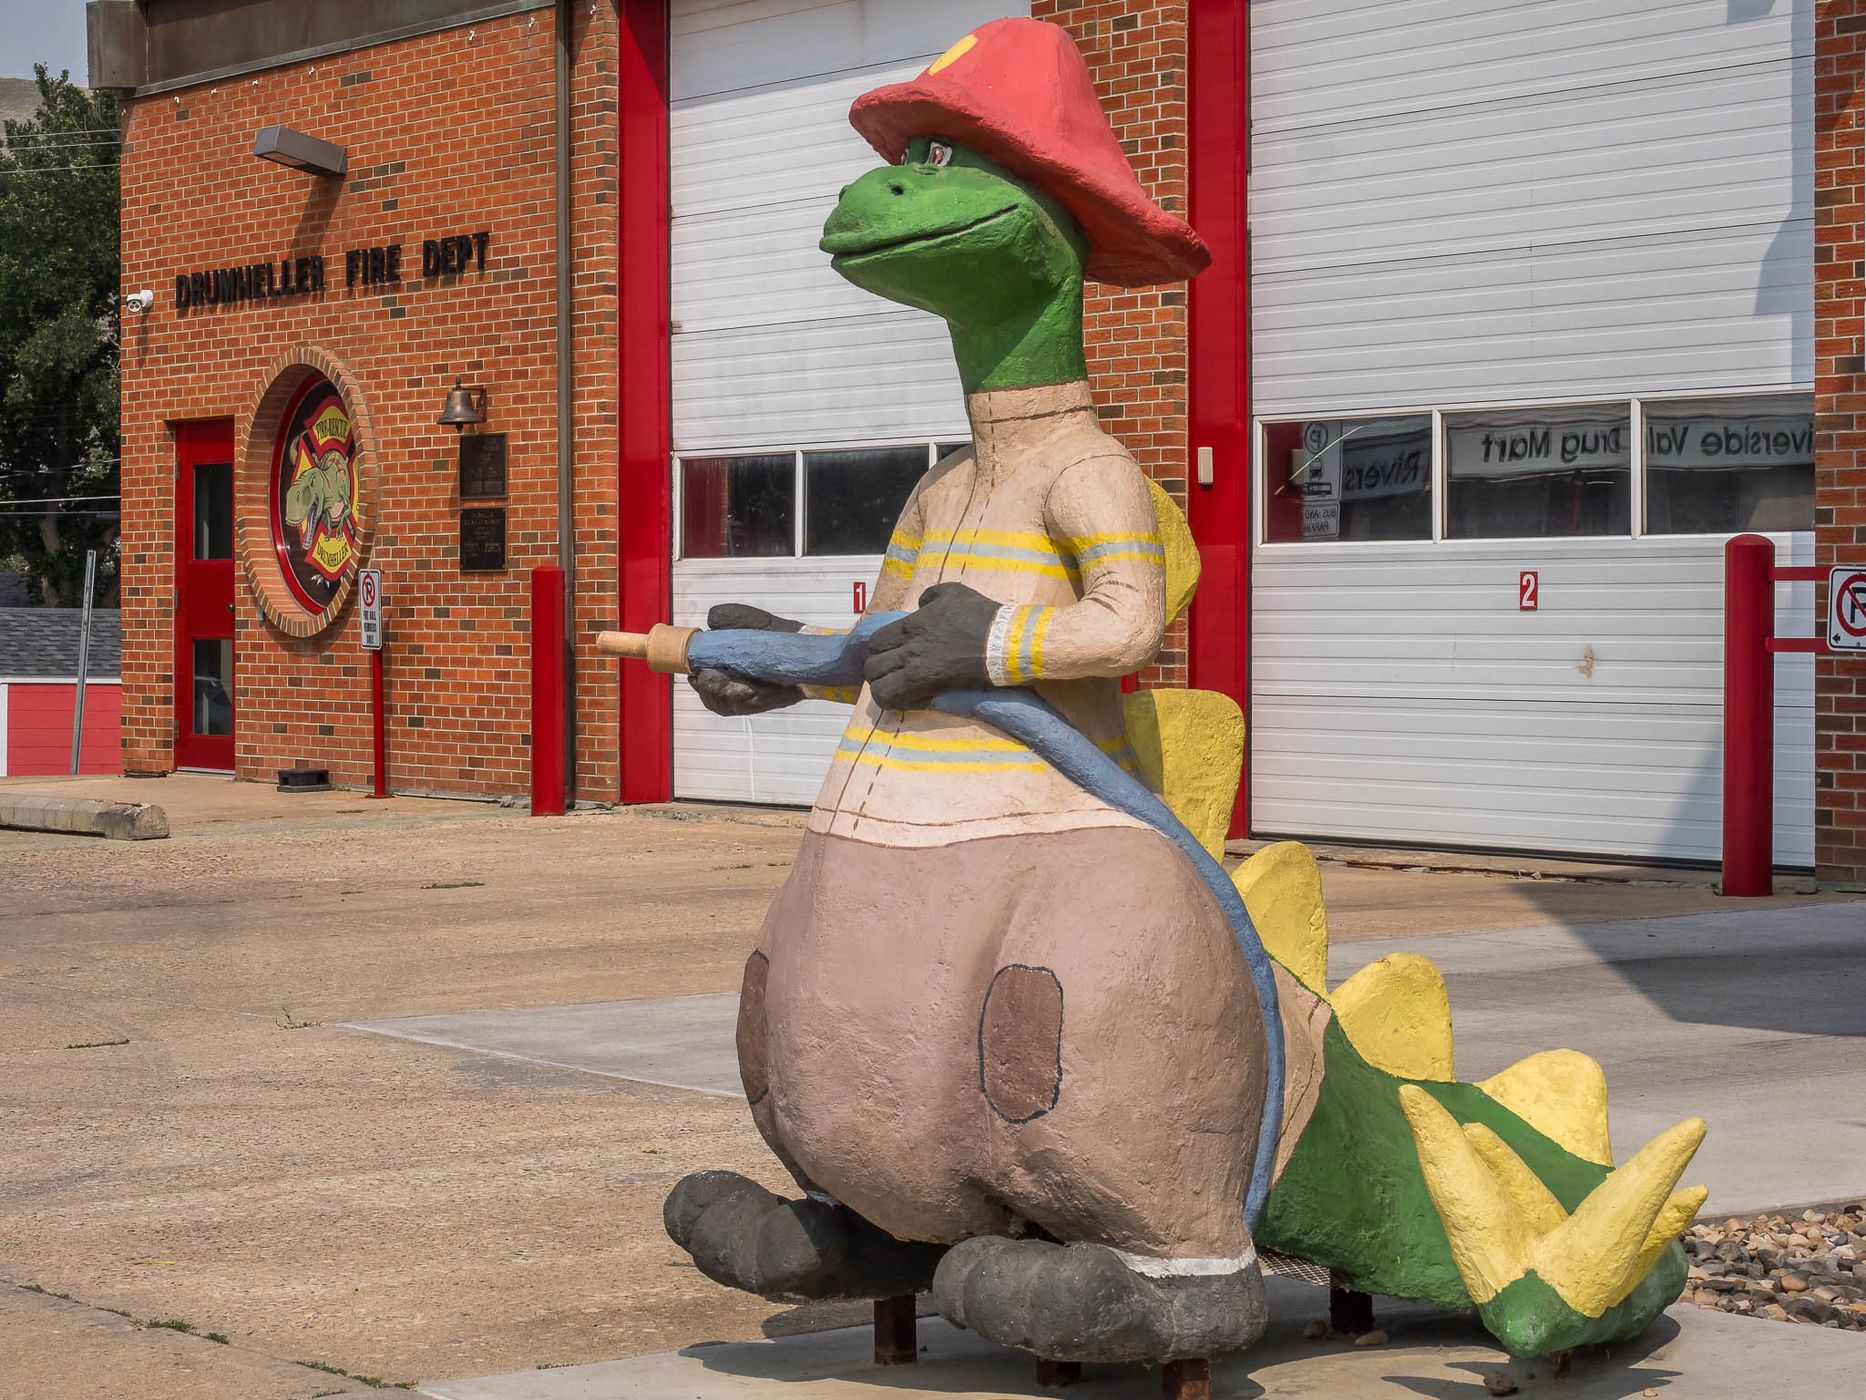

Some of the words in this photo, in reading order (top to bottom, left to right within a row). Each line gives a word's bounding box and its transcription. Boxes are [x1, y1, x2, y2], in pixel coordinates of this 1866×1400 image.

[176, 256, 325, 309] DRUMHELLER
[346, 244, 402, 288] FIRE
[423, 232, 490, 277] DEPT
[855, 583, 863, 611] 1
[1522, 573, 1535, 607] 2
